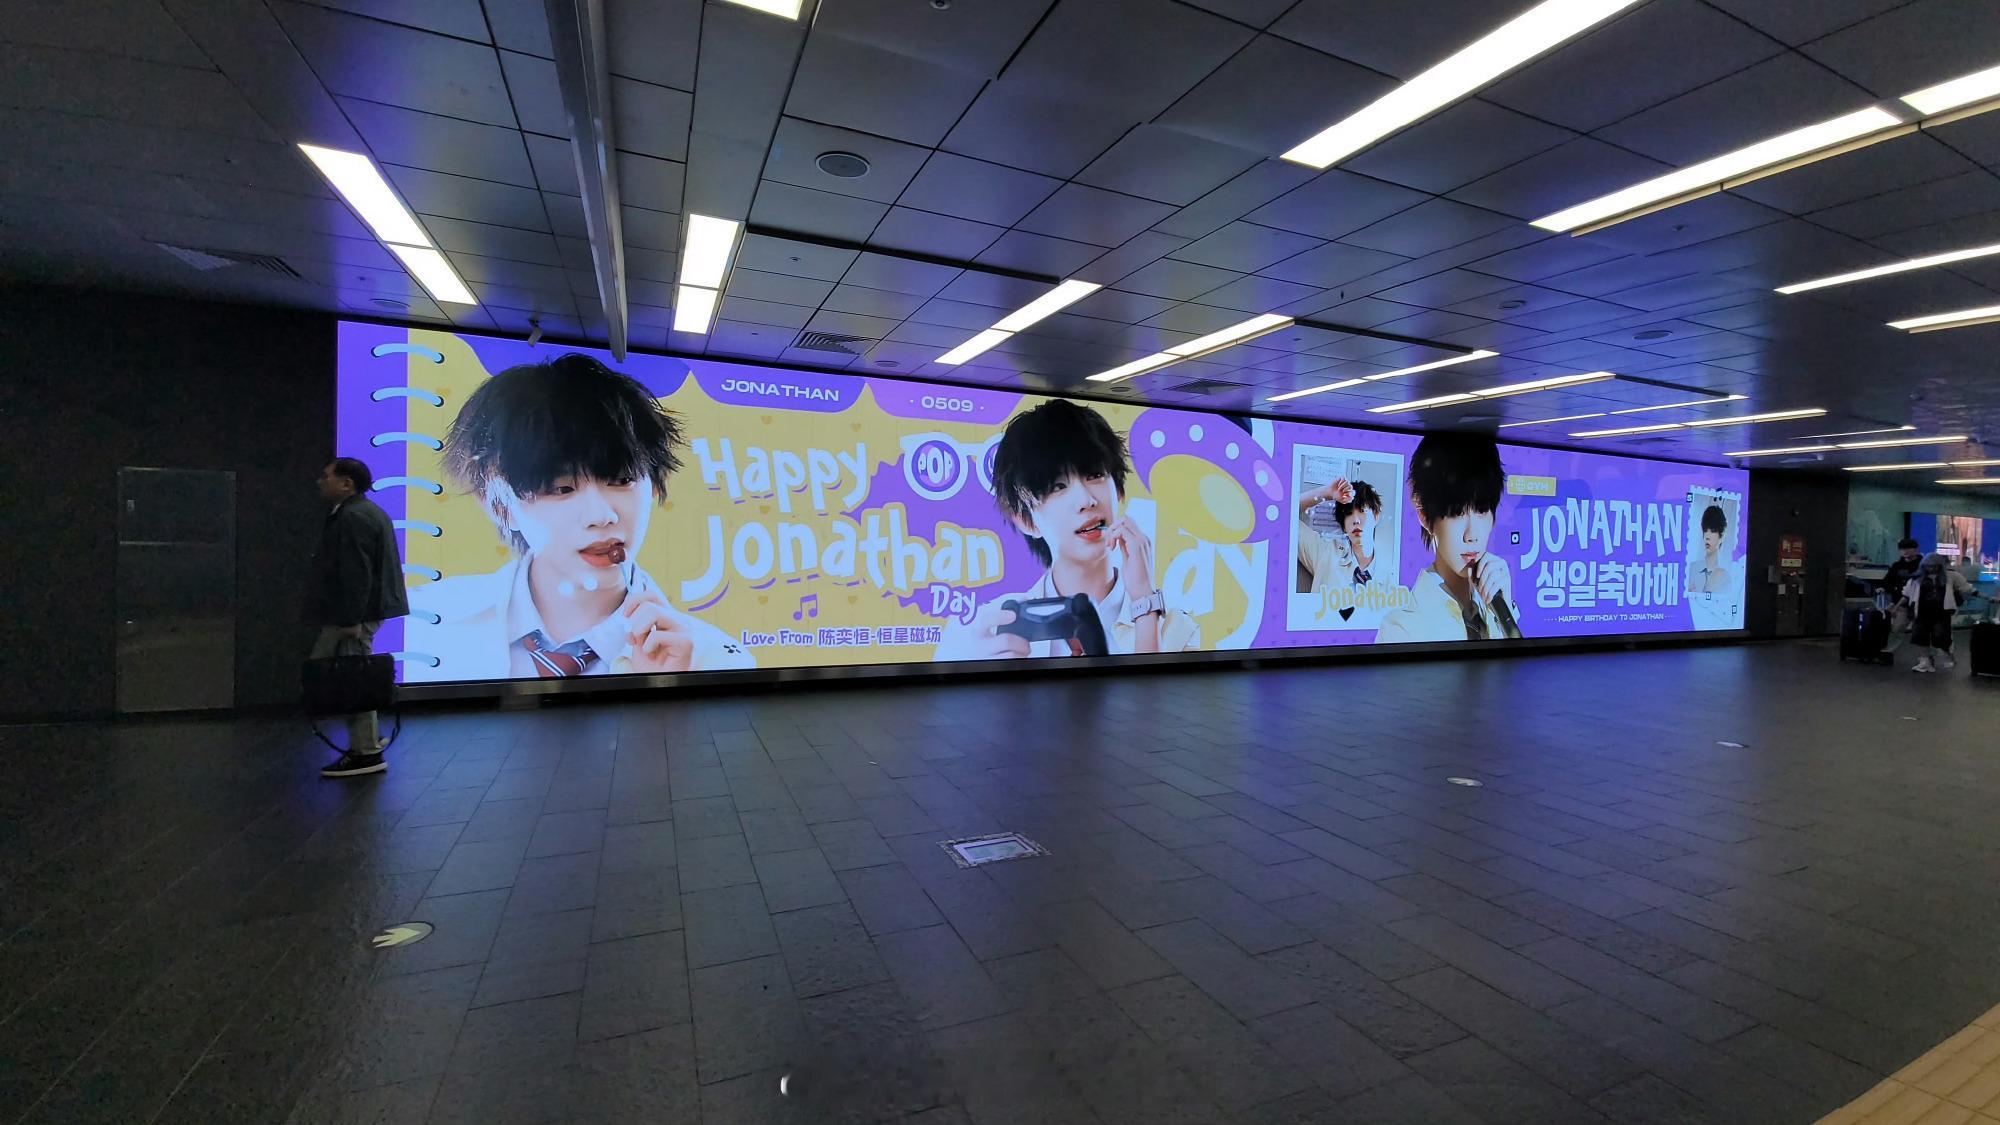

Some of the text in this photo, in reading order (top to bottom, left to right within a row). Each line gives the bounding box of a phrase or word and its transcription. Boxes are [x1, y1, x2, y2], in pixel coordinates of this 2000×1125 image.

[721, 379, 839, 401] JONATHAN
[921, 396, 974, 412] 0509
[692, 437, 868, 513] Happy
[918, 446, 953, 484] POP
[1520, 497, 1682, 570] JONATHAN
[680, 506, 1000, 603] Jonathan
[1315, 579, 1410, 619] Jonathan
[1536, 561, 1679, 608] 생일축하해
[930, 585, 976, 624] Day
[1584, 614, 1618, 622] BIRTHDAY
[1629, 613, 1664, 621] JONATHAN
[743, 627, 942, 646] Love From 陈奕恒-恒星磁场
